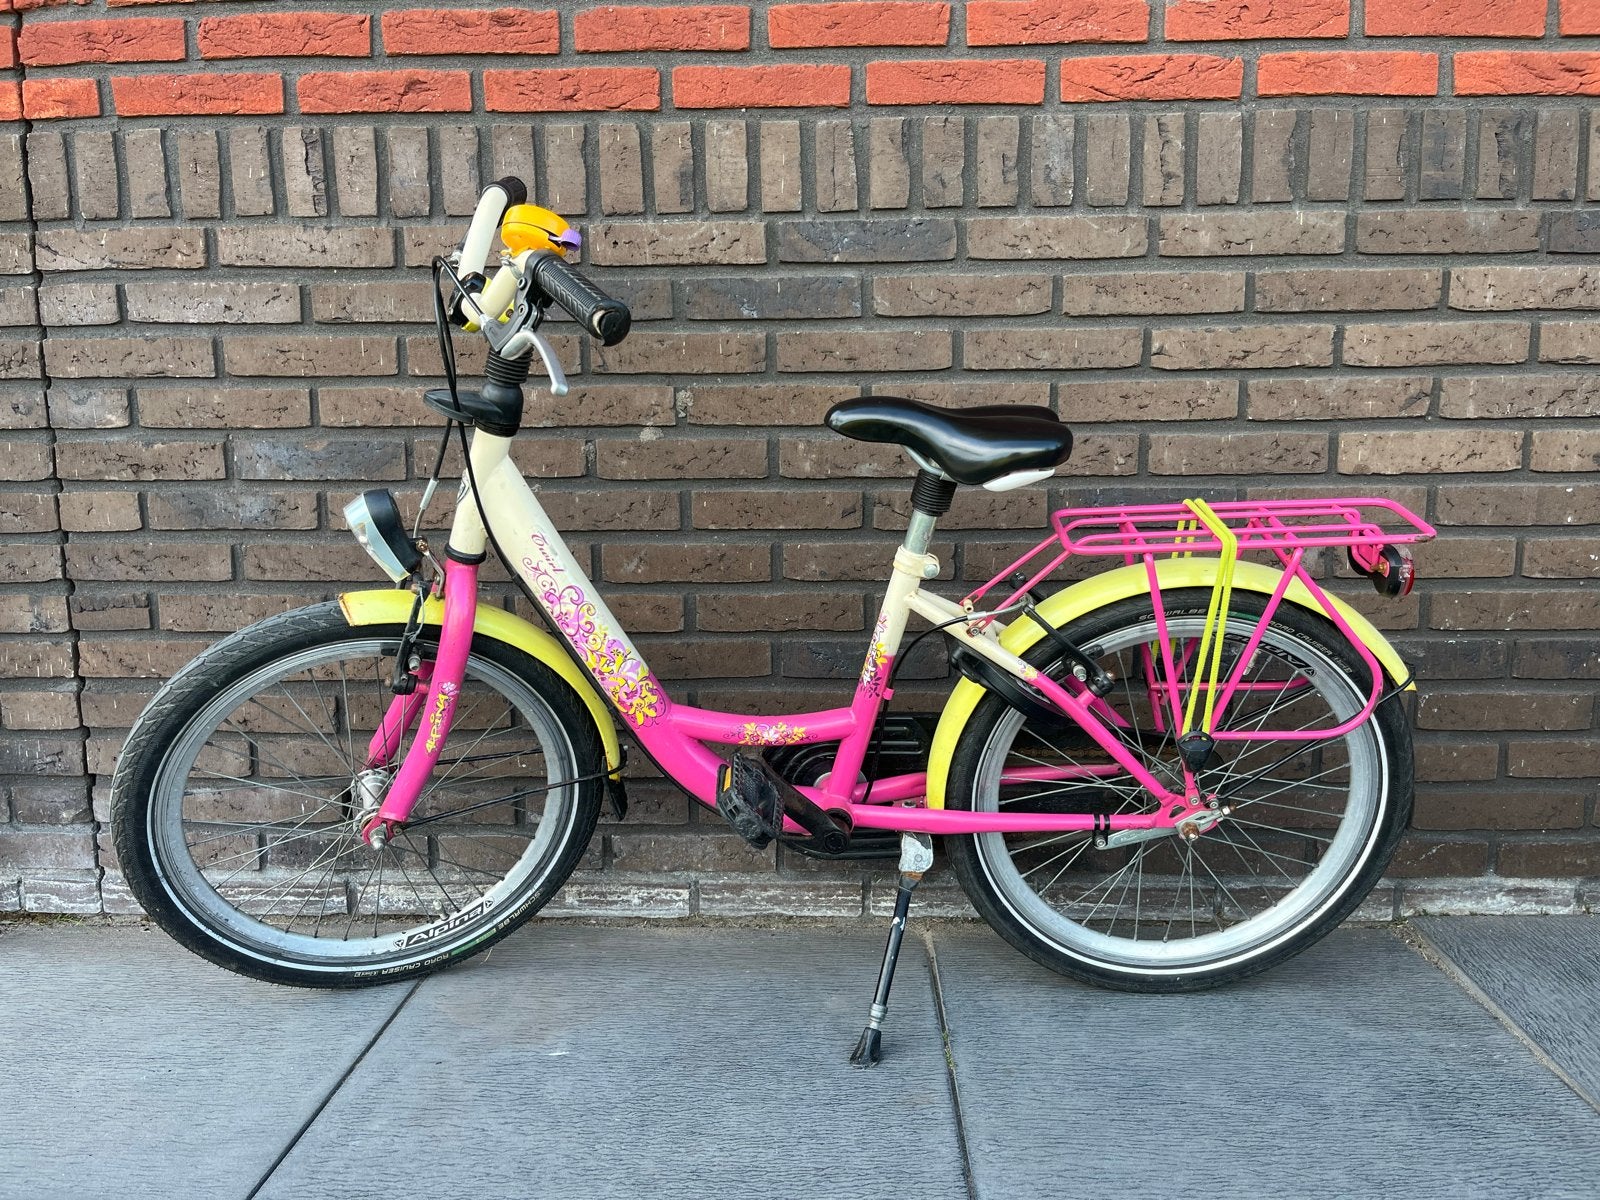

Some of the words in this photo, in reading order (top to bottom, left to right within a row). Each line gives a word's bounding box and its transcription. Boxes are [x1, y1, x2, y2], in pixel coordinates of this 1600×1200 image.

[1138, 608, 1207, 622] SCWALBE
[1296, 632, 1333, 656] CRUISER
[498, 887, 545, 930] SCHWALBE
[409, 905, 484, 944] Alpina
[382, 961, 421, 976] CRUISER
[425, 953, 449, 967] ROAD
